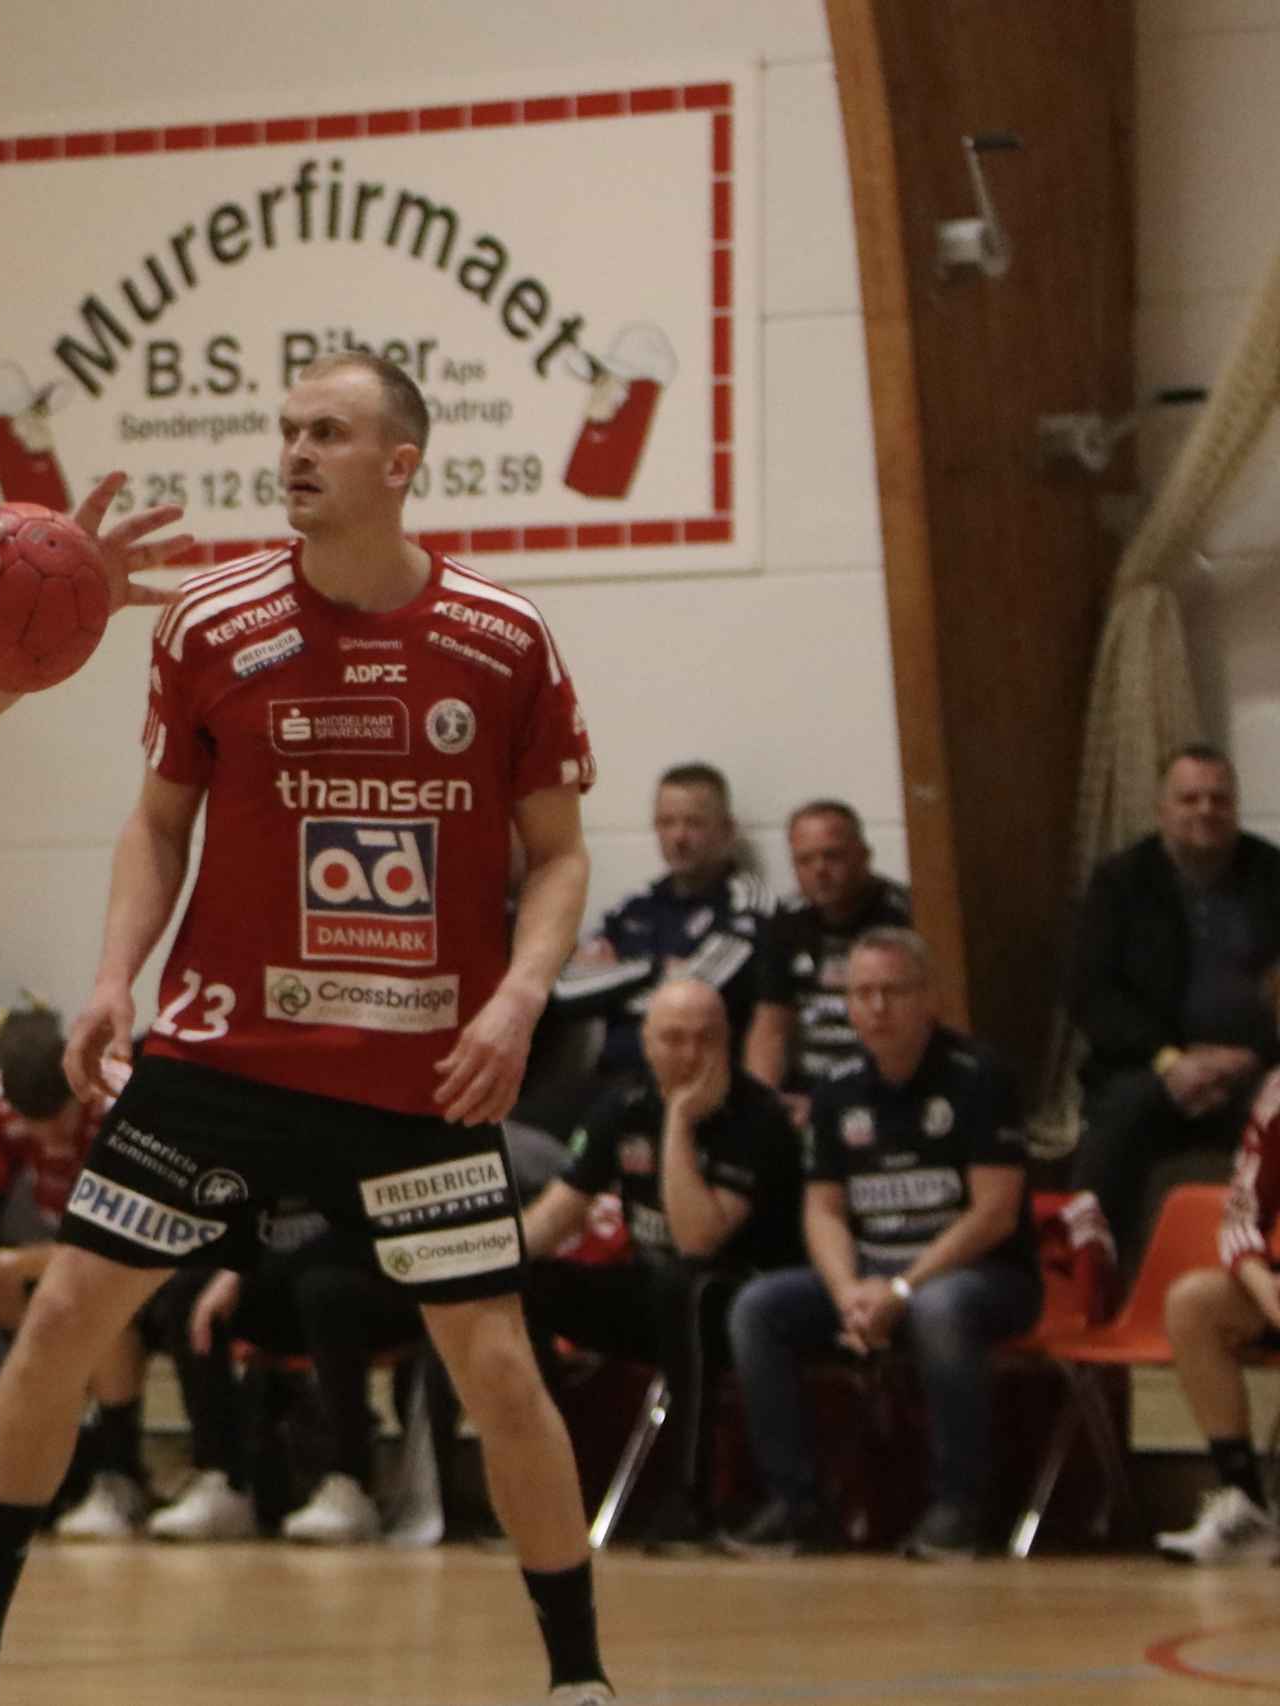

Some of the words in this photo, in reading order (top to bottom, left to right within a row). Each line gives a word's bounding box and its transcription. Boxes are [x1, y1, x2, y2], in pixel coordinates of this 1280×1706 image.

[53, 158, 584, 398] Murerfirmaet
[146, 335, 258, 398] B.S.
[202, 470, 241, 509] 12
[443, 458, 486, 498] 52
[499, 453, 543, 495] 59
[205, 593, 299, 646] KENTAUR
[432, 600, 535, 651] KENTAUR
[276, 770, 473, 811] thansen
[318, 926, 425, 951] DANMARK
[151, 968, 237, 1042] 23
[318, 980, 456, 1016] Crossbridge
[375, 1163, 499, 1206] FREDERICIA
